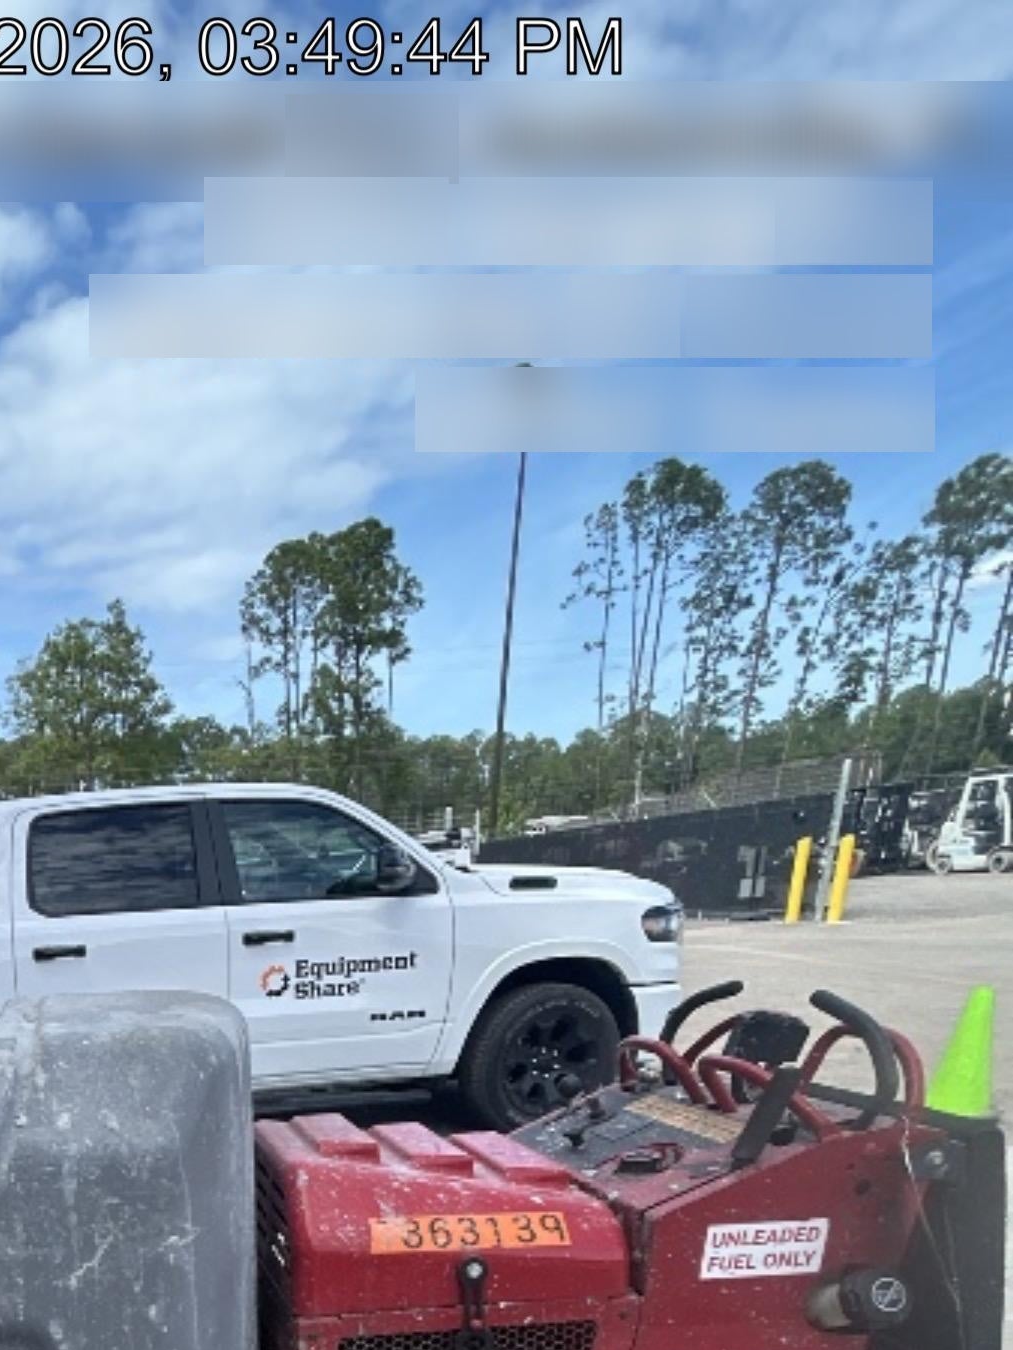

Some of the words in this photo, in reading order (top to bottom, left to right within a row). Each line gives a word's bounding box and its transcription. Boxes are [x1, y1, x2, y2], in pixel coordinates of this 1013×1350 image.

[295, 951, 418, 980] Equipment
[295, 980, 360, 999] Share
[403, 1214, 565, 1249] 363139
[712, 1226, 820, 1248] UNLEADED
[708, 1254, 756, 1272] FUEL
[763, 1250, 816, 1268] ONLY
